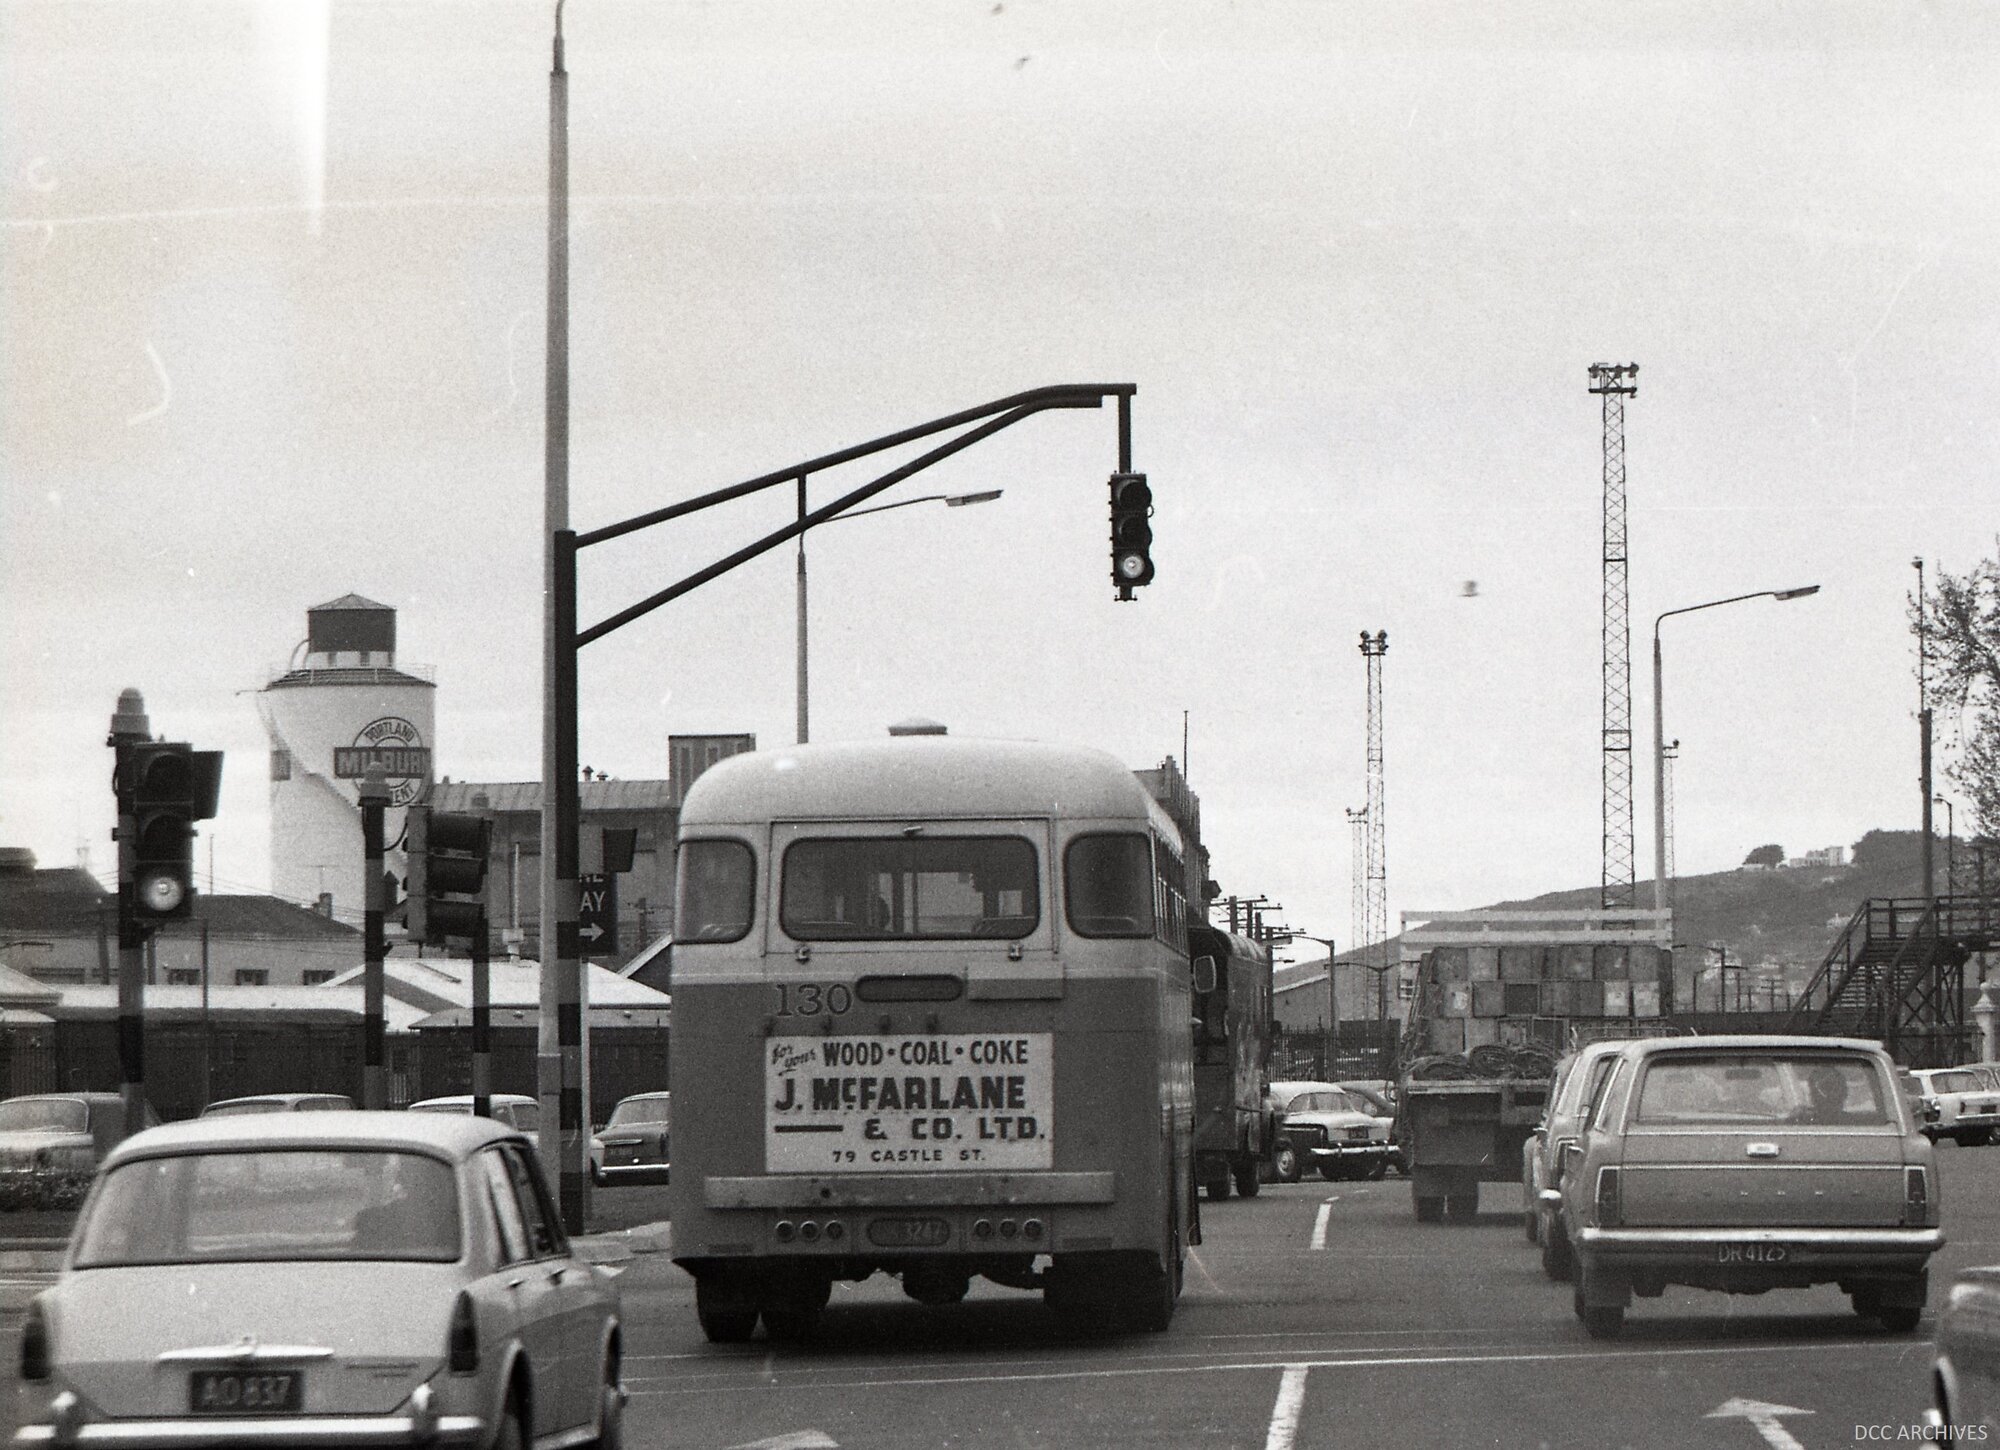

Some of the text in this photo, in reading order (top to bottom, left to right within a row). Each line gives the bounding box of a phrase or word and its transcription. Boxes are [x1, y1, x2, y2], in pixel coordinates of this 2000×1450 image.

[364, 722, 415, 743] PORTLAND
[580, 890, 606, 912] AY
[776, 983, 851, 1017] 130
[822, 1042, 883, 1066] WOOD
[900, 1041, 952, 1065] COAL
[969, 1039, 1028, 1065] COKE
[774, 1078, 803, 1111] J.
[864, 1116, 1046, 1140] & CO. LTD.
[832, 1148, 986, 1163] 79 CASTLE ST.
